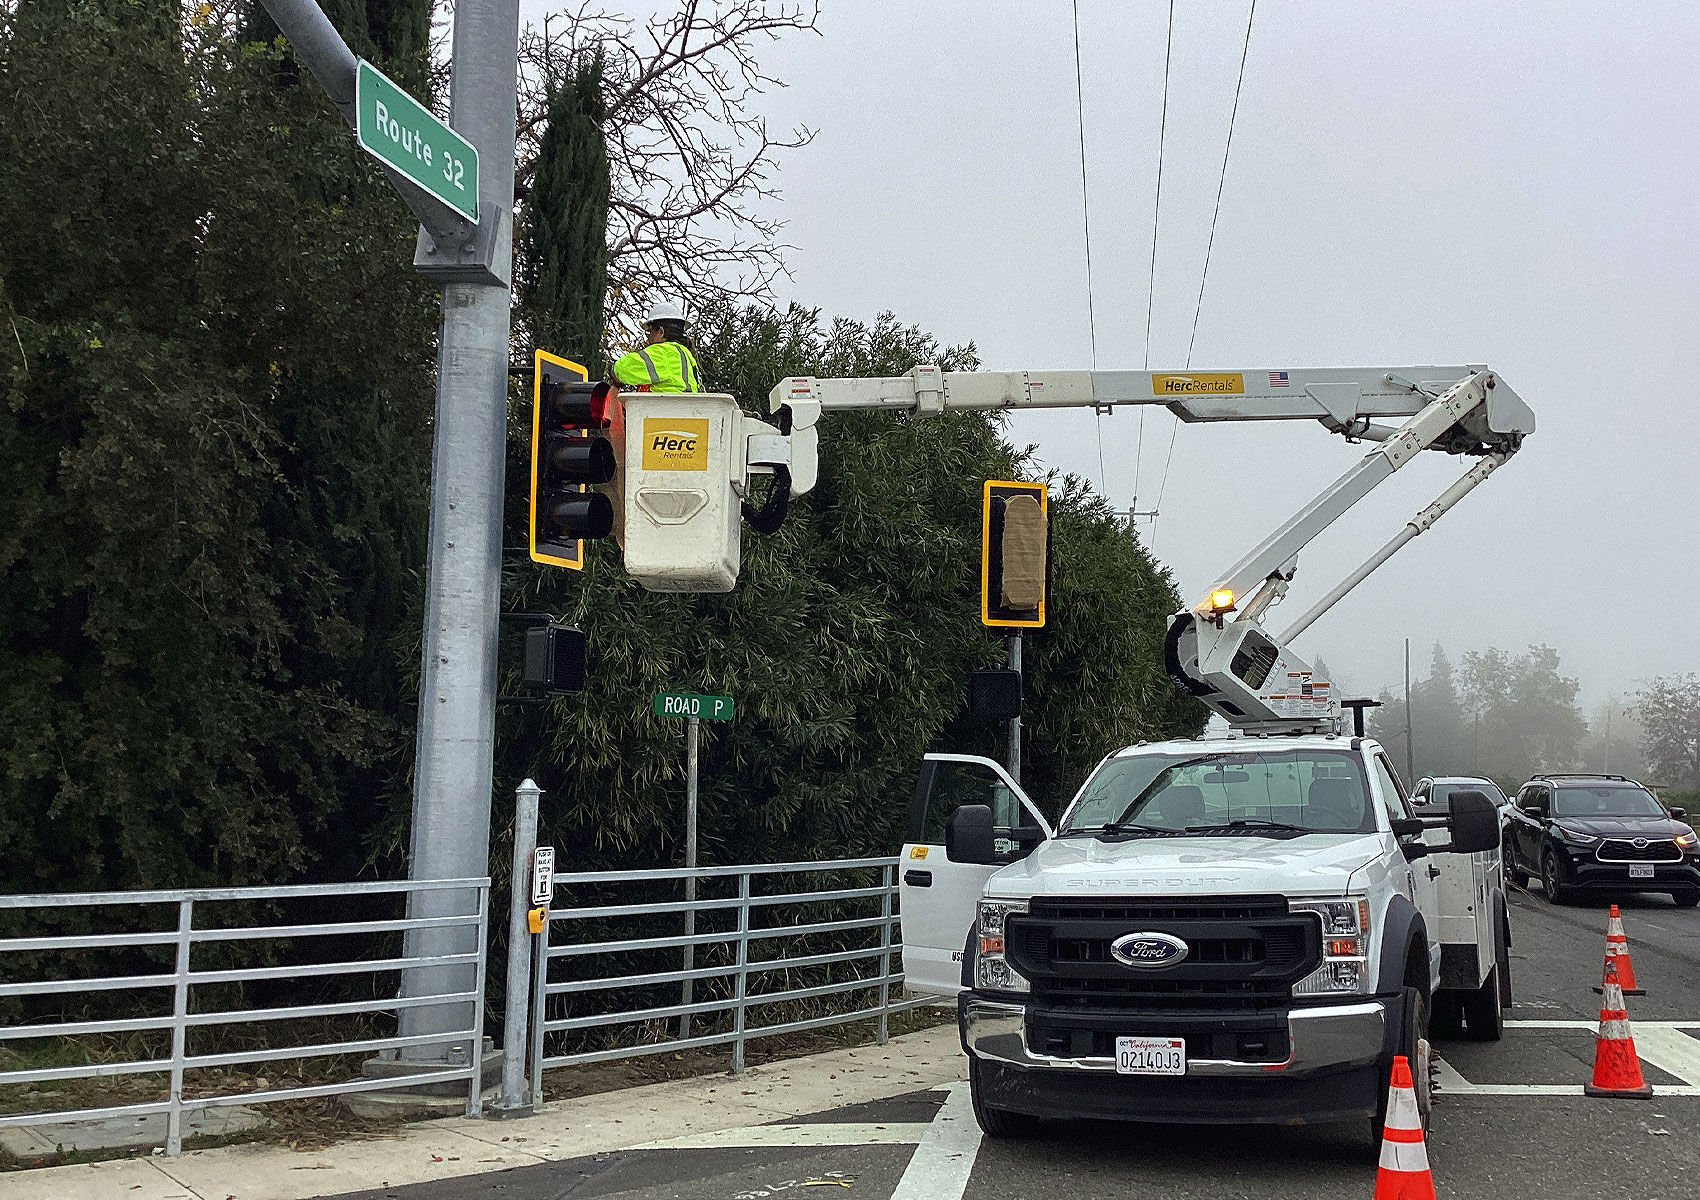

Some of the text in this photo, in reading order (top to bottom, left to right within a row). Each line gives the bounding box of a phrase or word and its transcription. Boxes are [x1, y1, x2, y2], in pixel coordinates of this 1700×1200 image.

[375, 99, 465, 191] Route 32
[652, 436, 697, 451] Herc
[664, 451, 694, 459] Rentals
[664, 696, 724, 716] ROAD P
[1066, 877, 1241, 888] SUPER DUTY
[1130, 941, 1166, 958] Ford
[1129, 1040, 1168, 1051] California
[1121, 1051, 1181, 1069] 02140J3
